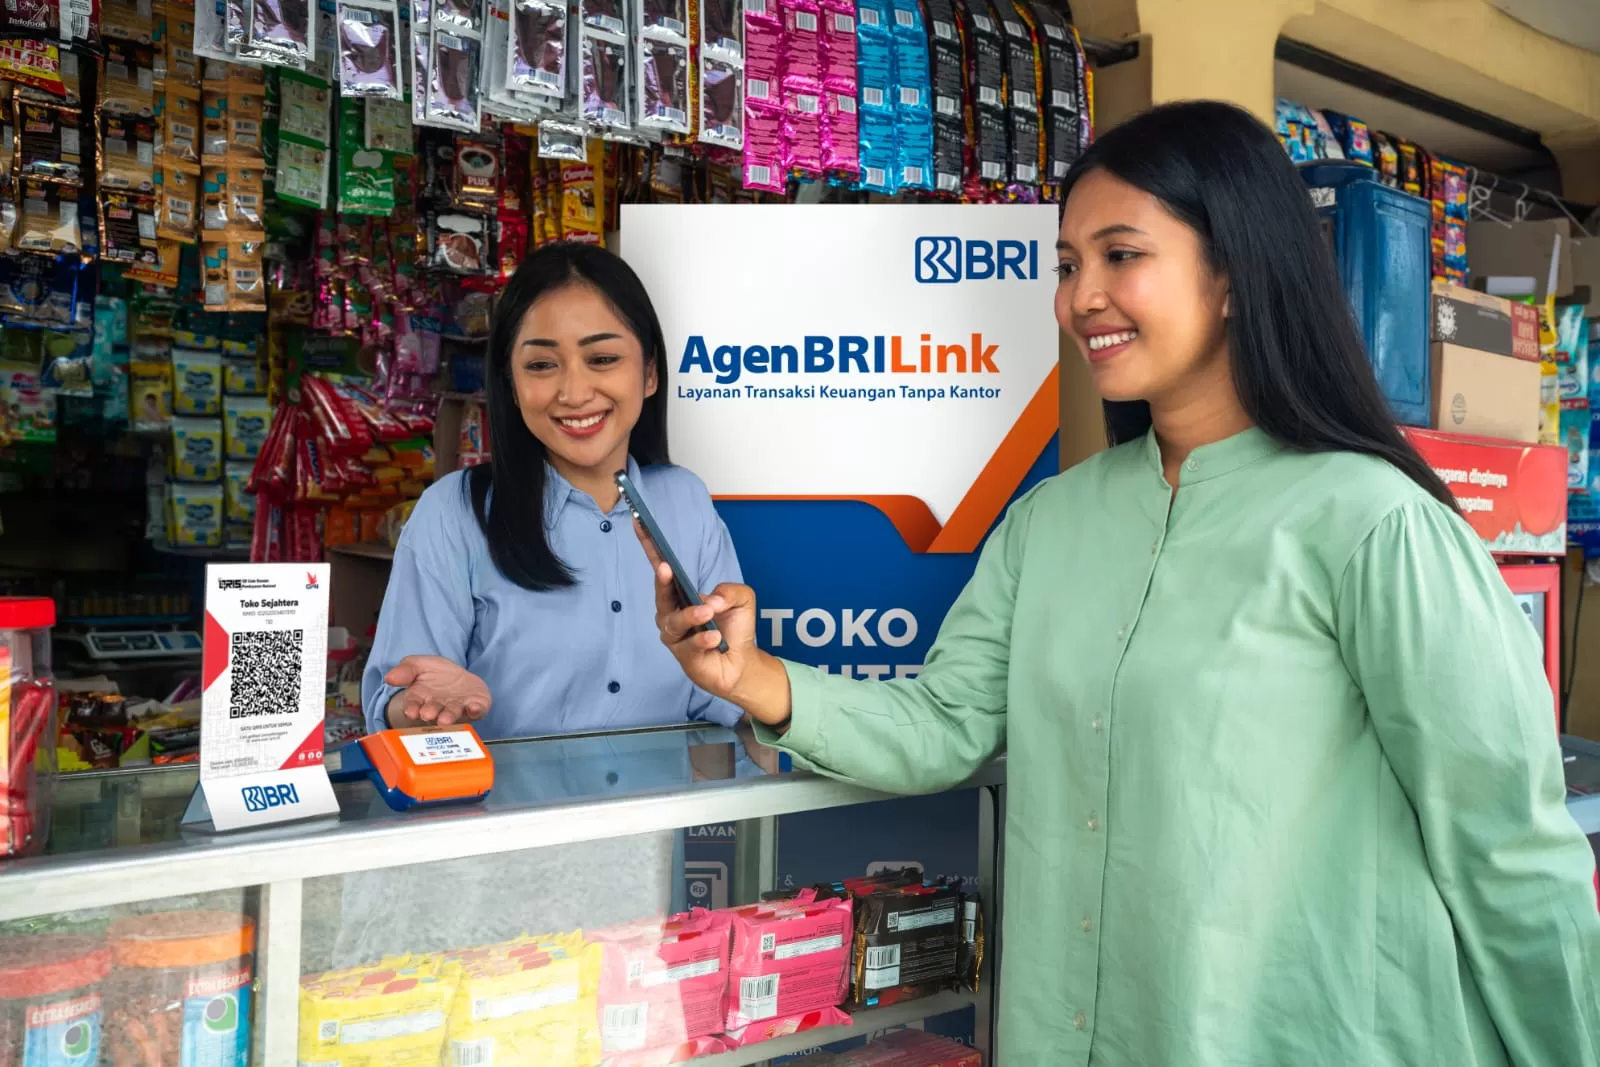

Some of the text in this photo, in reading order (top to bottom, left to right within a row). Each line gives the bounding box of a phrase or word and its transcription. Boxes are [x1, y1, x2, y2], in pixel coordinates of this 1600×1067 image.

[467, 175, 490, 186] PLUS
[965, 239, 1039, 280] BRI
[678, 333, 1001, 385] AgenBRILink
[677, 385, 1001, 401] Layanan Transaksi Keuangan Tanpa Kantor
[240, 598, 299, 609] Toko Sejahtera
[760, 608, 918, 647] TOKO
[263, 783, 300, 807] BRI
